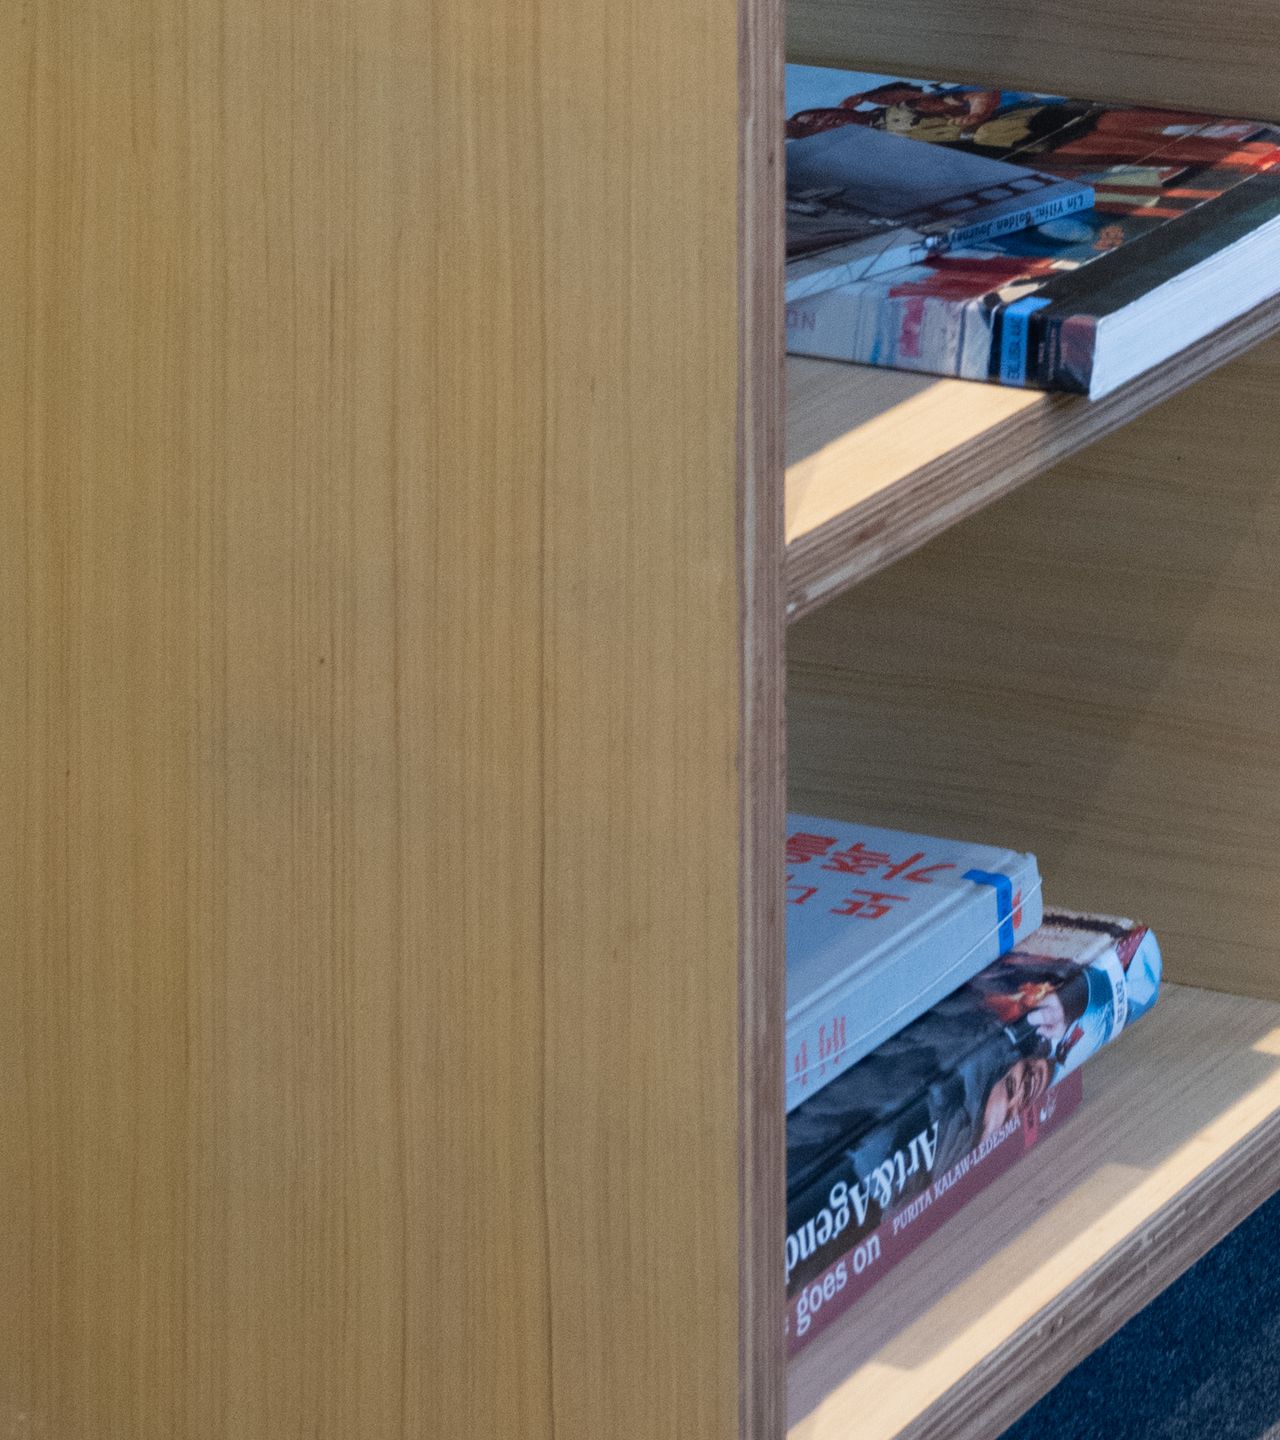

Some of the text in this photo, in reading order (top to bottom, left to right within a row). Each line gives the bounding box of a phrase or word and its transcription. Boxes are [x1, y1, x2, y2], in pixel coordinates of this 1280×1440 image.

[891, 1115, 1022, 1236] PURITA KALAW-LEDESMA
[795, 1235, 881, 1336] goes on
